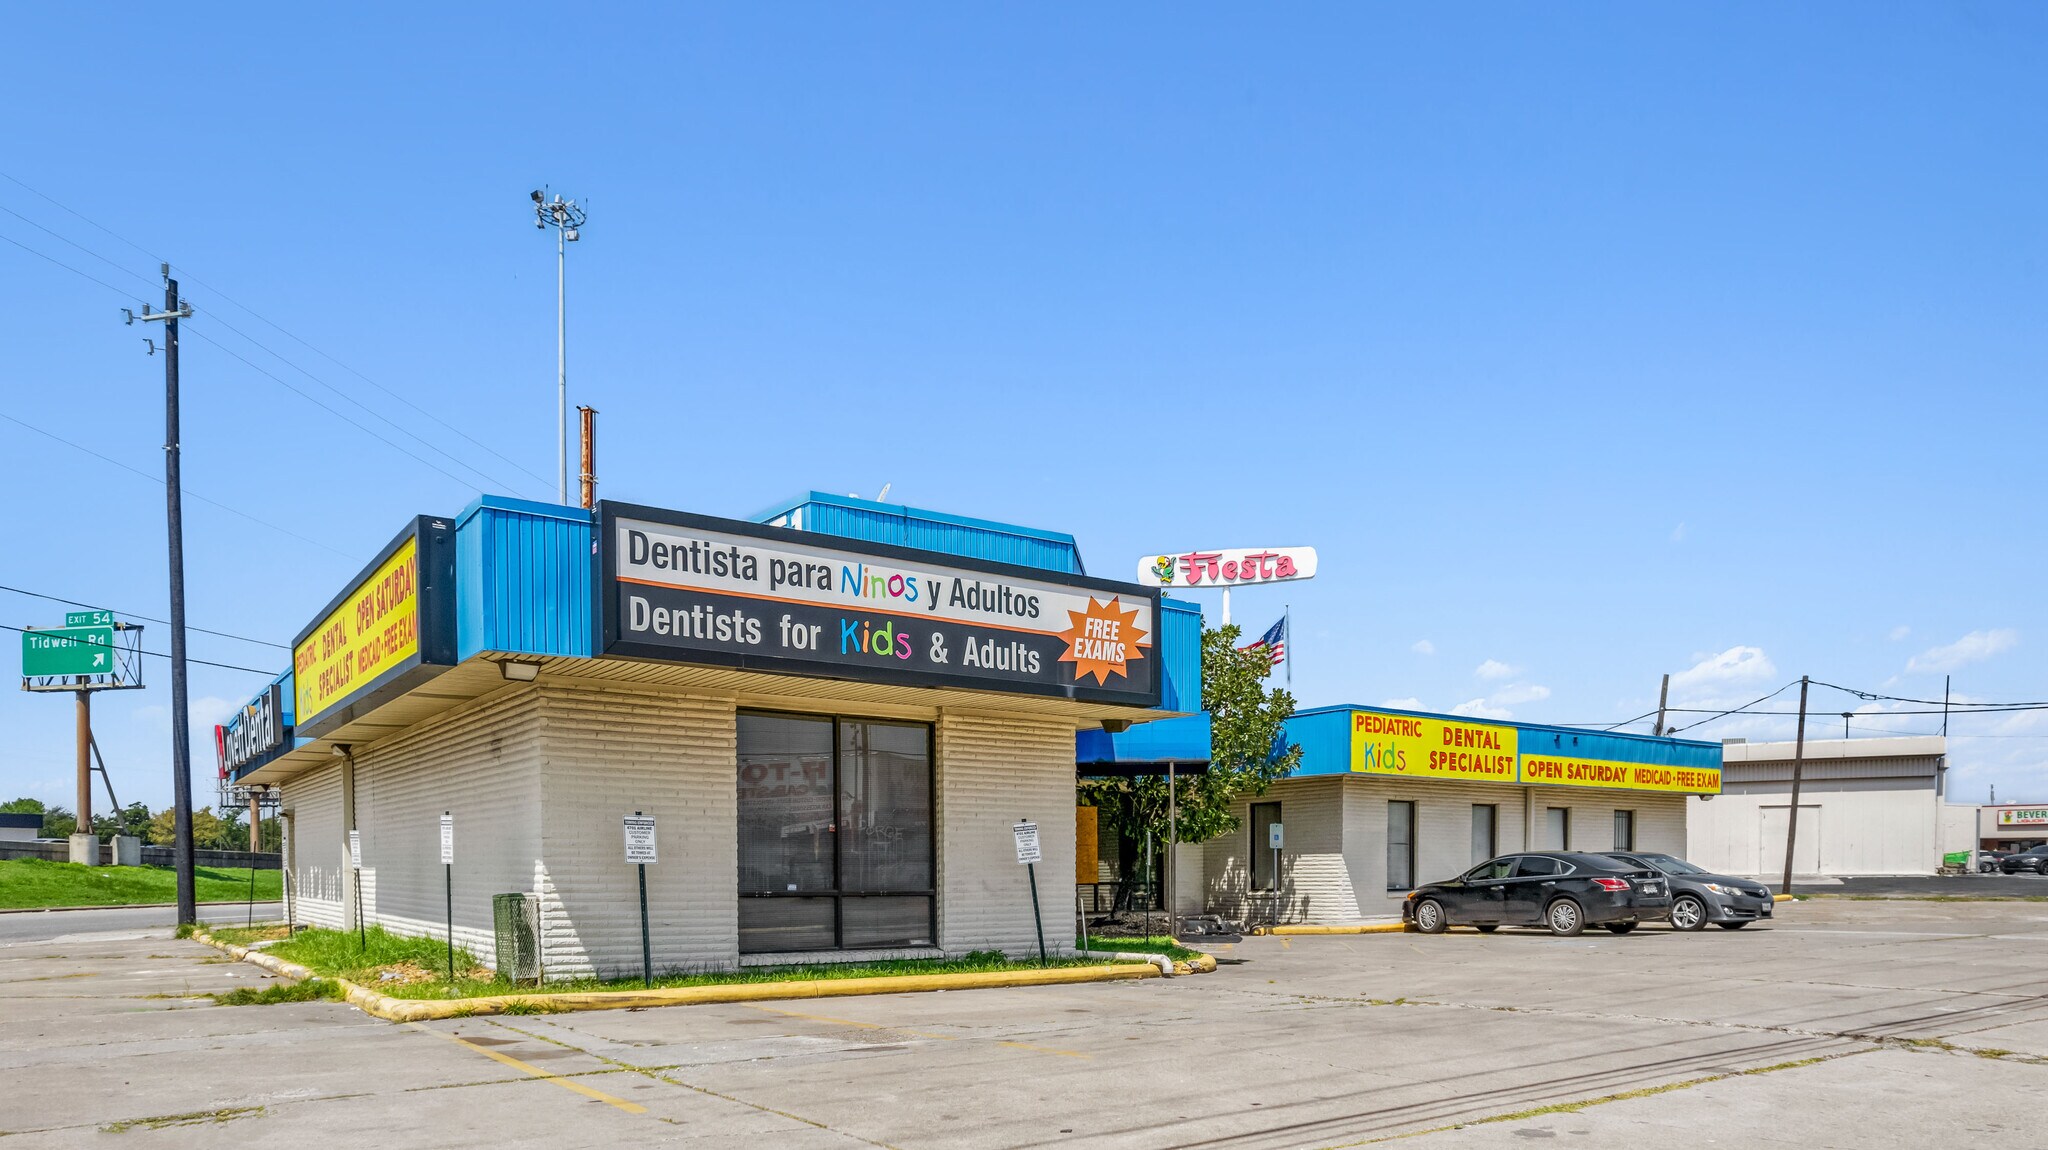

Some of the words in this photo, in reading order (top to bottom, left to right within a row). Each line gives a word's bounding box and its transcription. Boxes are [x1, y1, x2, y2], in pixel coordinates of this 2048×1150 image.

[628, 529, 758, 581] Dentista
[769, 557, 832, 592] para
[841, 563, 918, 603] Ninos
[927, 579, 942, 611] y
[949, 577, 1040, 619] Adultos
[1178, 550, 1298, 585] Fiesta
[356, 590, 375, 637] OPEN
[376, 553, 416, 621] SATURDAY
[68, 615, 86, 624] EXIT
[93, 612, 110, 624] 54
[1084, 617, 1121, 641] FREE
[30, 635, 77, 649] Tidwell
[88, 634, 105, 646] Rd
[296, 640, 317, 677] PEDIATRIC
[322, 616, 347, 662] DENTAL
[358, 635, 381, 675] MEDICAID
[383, 623, 398, 659] FREE
[399, 610, 417, 649] EXAM
[629, 595, 762, 645] Dentists
[780, 614, 822, 651] for
[840, 617, 912, 660] Kids
[929, 631, 949, 664] &
[963, 636, 1040, 674] Adults
[1073, 637, 1126, 663] EXAMS
[319, 649, 354, 702] SPECIALIST
[243, 684, 276, 760] Dental
[1356, 714, 1423, 738] PEDIATRIC
[1443, 726, 1501, 750] DENTAL
[1364, 741, 1406, 771] Kids
[1429, 750, 1513, 775] SPECIALIST
[1527, 760, 1563, 779] OPEN
[1567, 762, 1628, 783] SATURDAY
[1634, 768, 1672, 786] MEDICAID
[1676, 770, 1695, 788] FREE
[1697, 771, 1719, 789] EXAM
